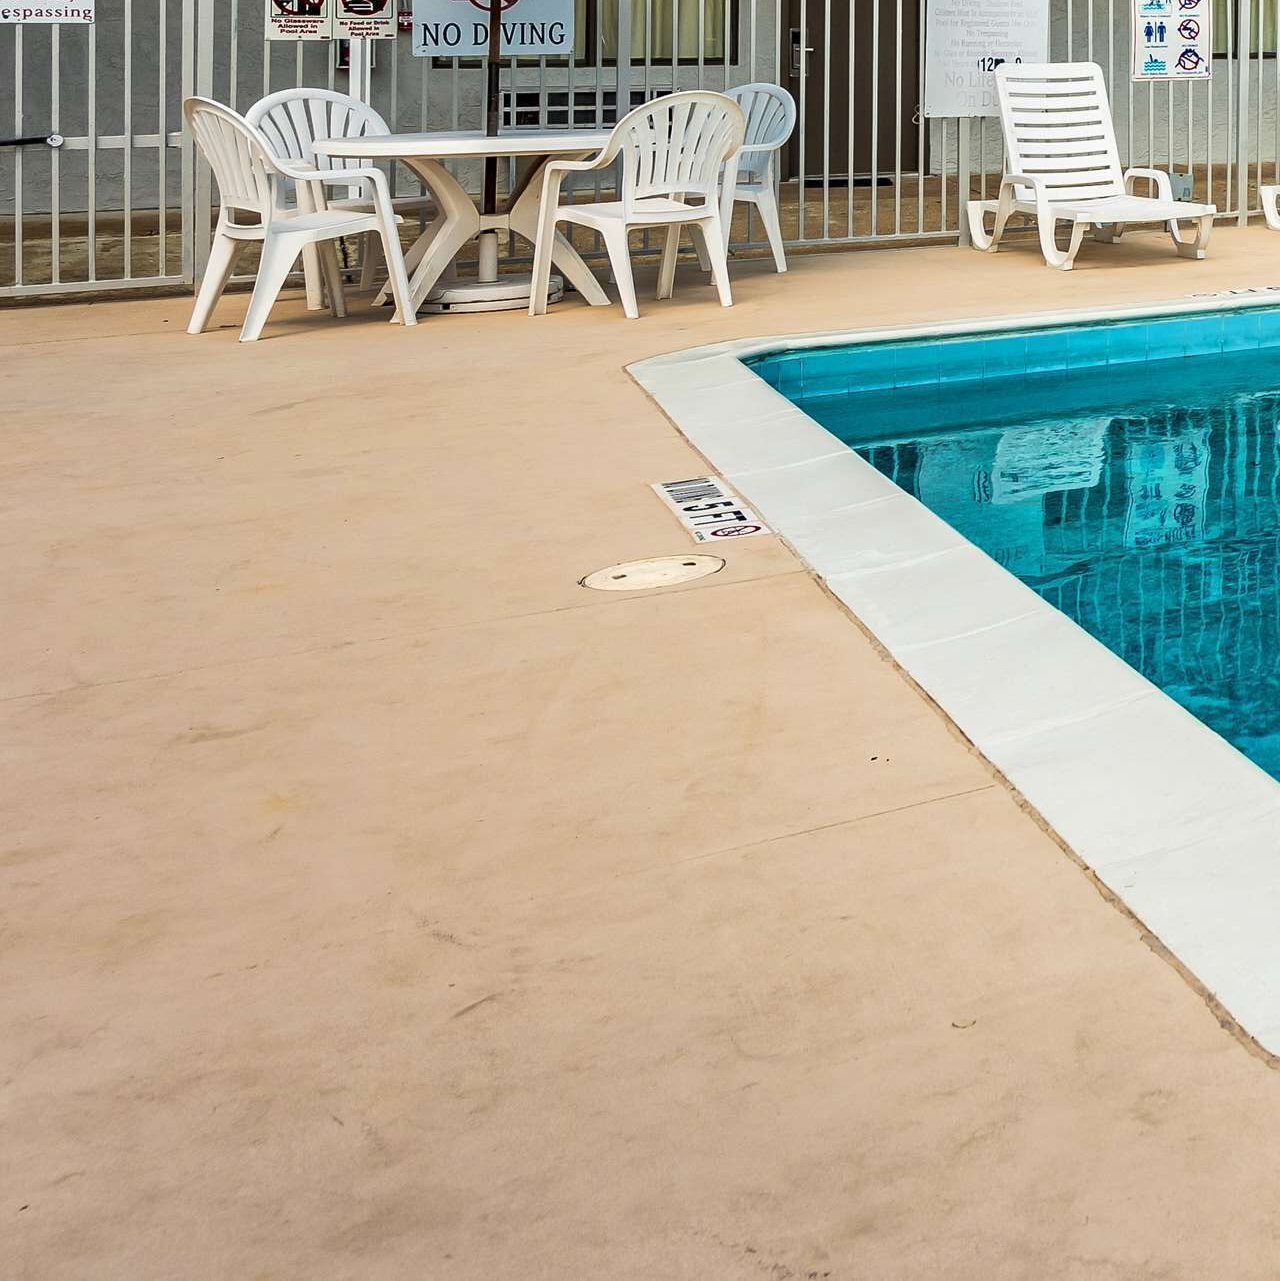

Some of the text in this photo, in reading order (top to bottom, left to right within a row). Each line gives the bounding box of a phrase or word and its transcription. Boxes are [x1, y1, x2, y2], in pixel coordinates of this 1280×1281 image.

[422, 21, 566, 46] NO DVING
[682, 501, 734, 512] 5
[689, 509, 747, 526] FT
